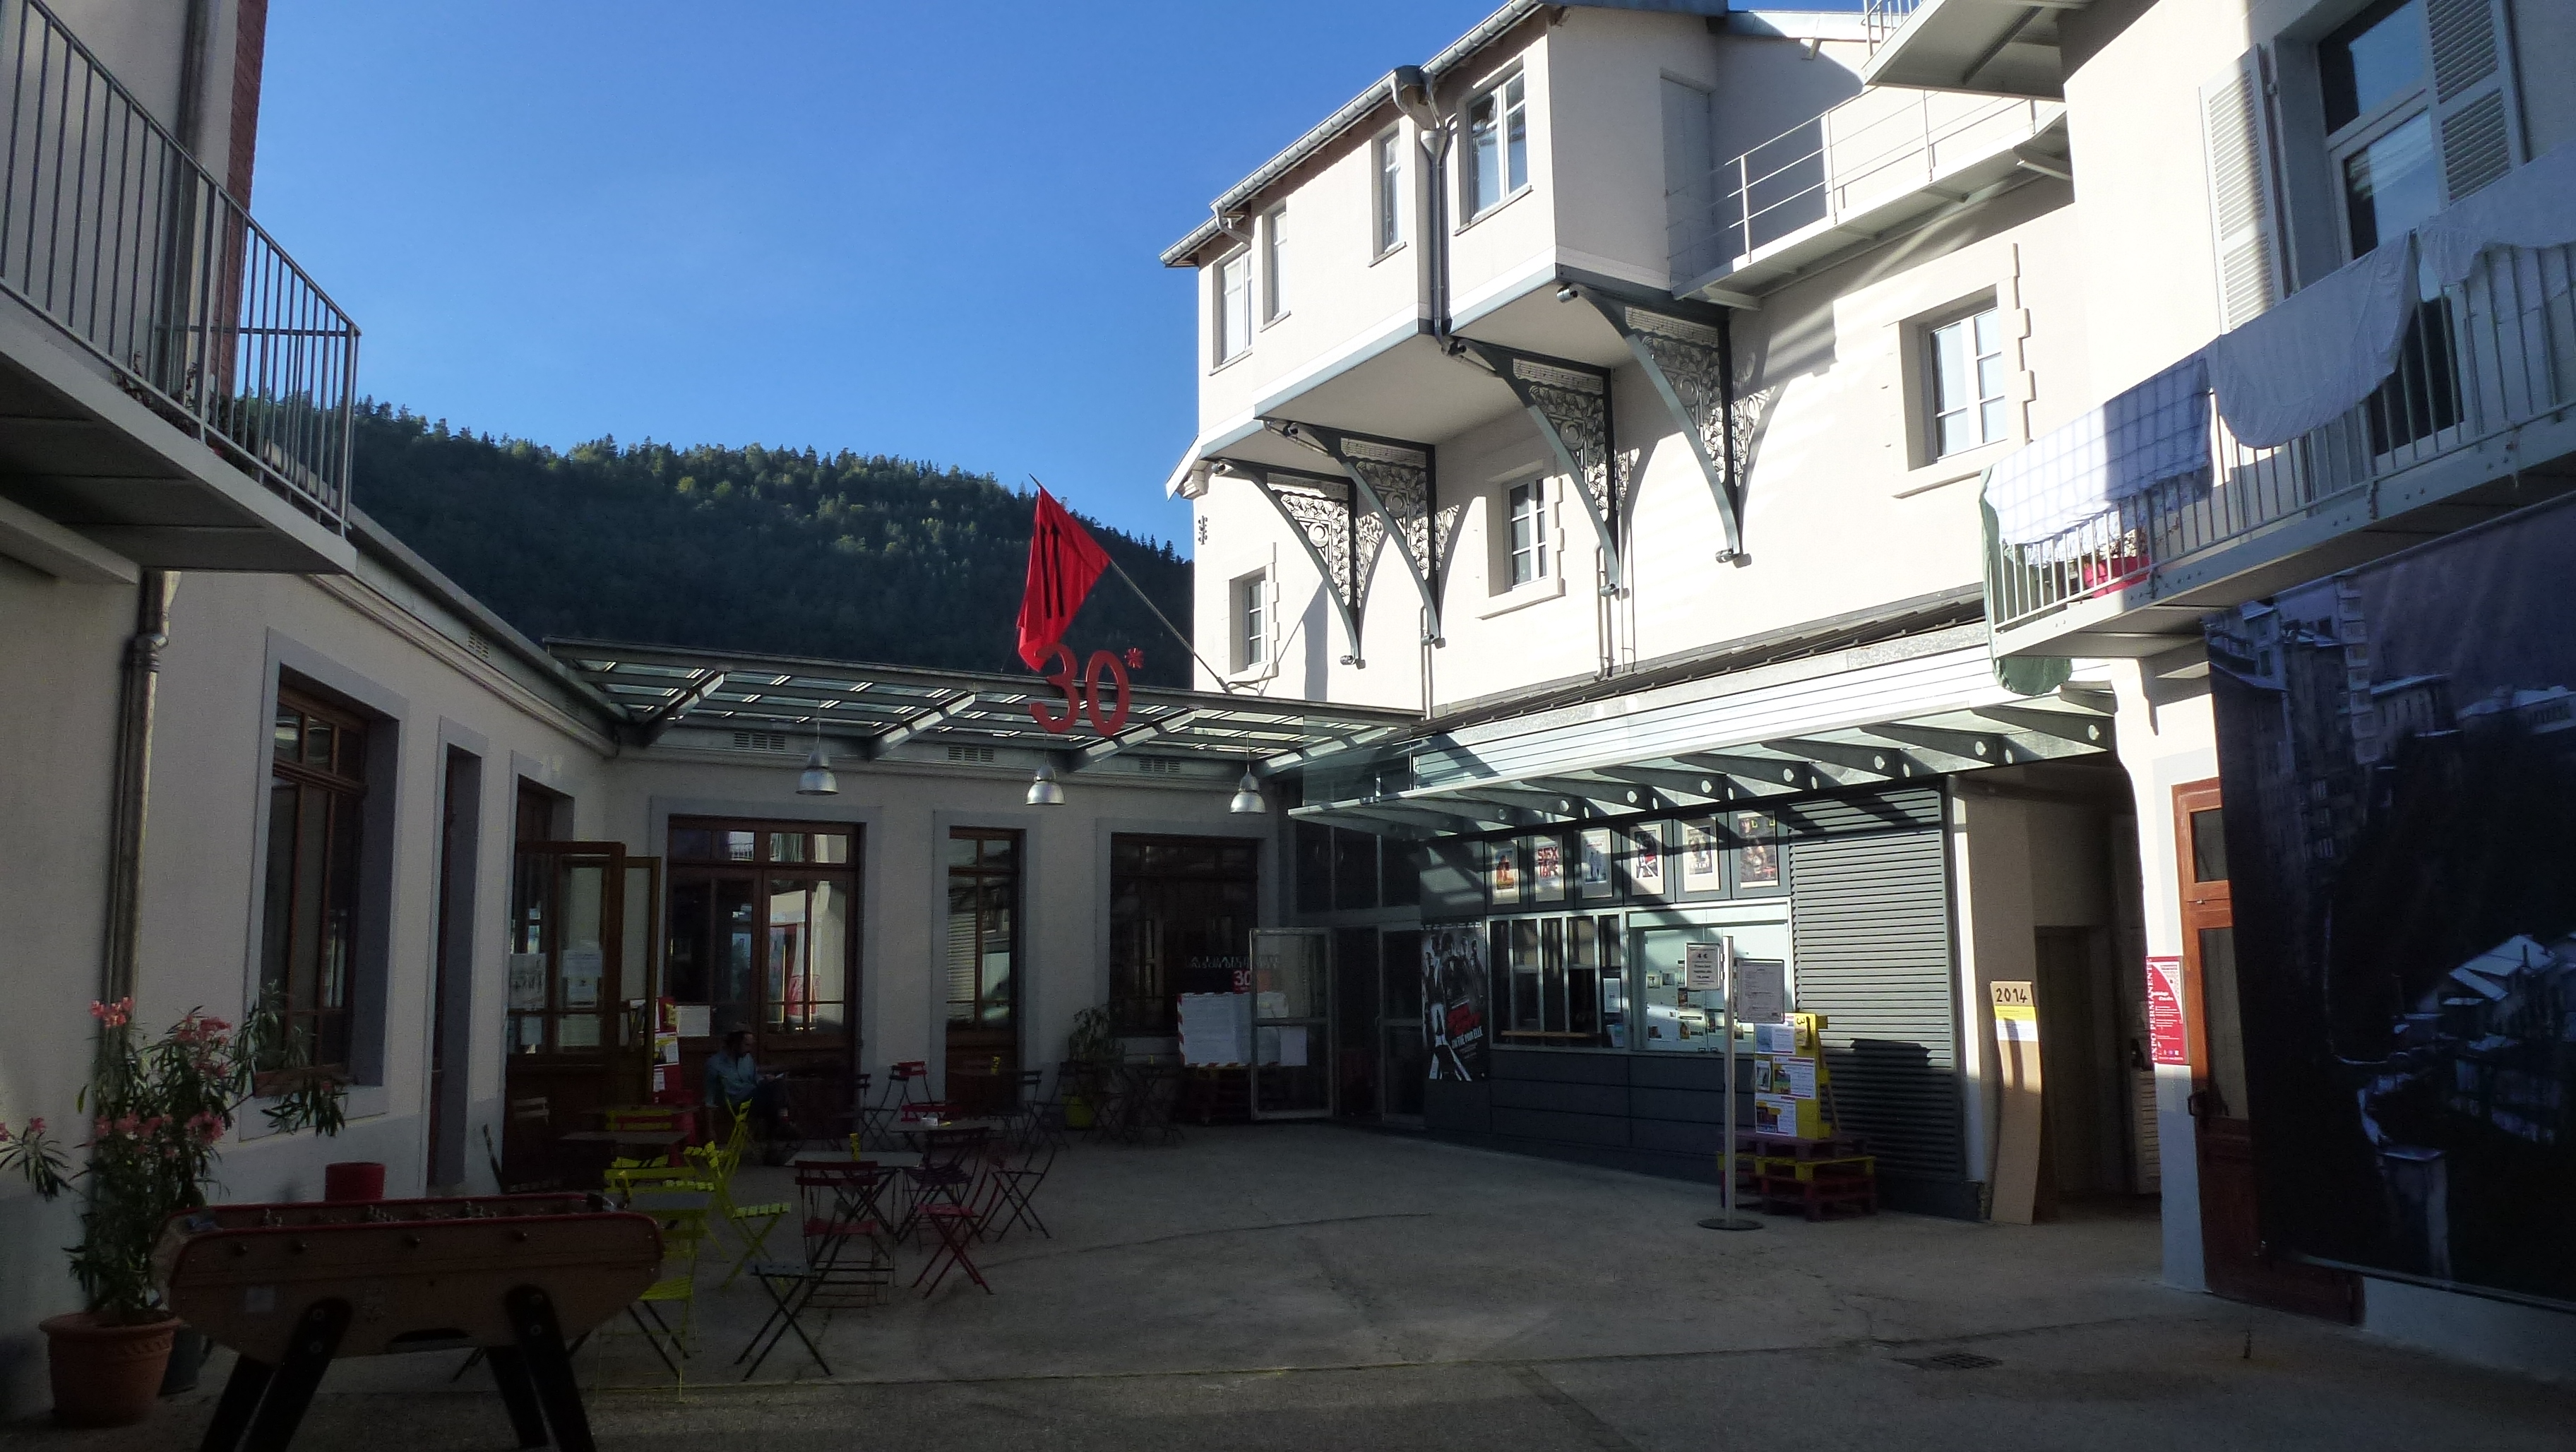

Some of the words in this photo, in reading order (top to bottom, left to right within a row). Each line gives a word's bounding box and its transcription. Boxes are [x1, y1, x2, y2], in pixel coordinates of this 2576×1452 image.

[1537, 846, 1558, 861] SEX
[1996, 987, 2028, 1004] 2014
[2146, 958, 2156, 1030] PERMANENTE
